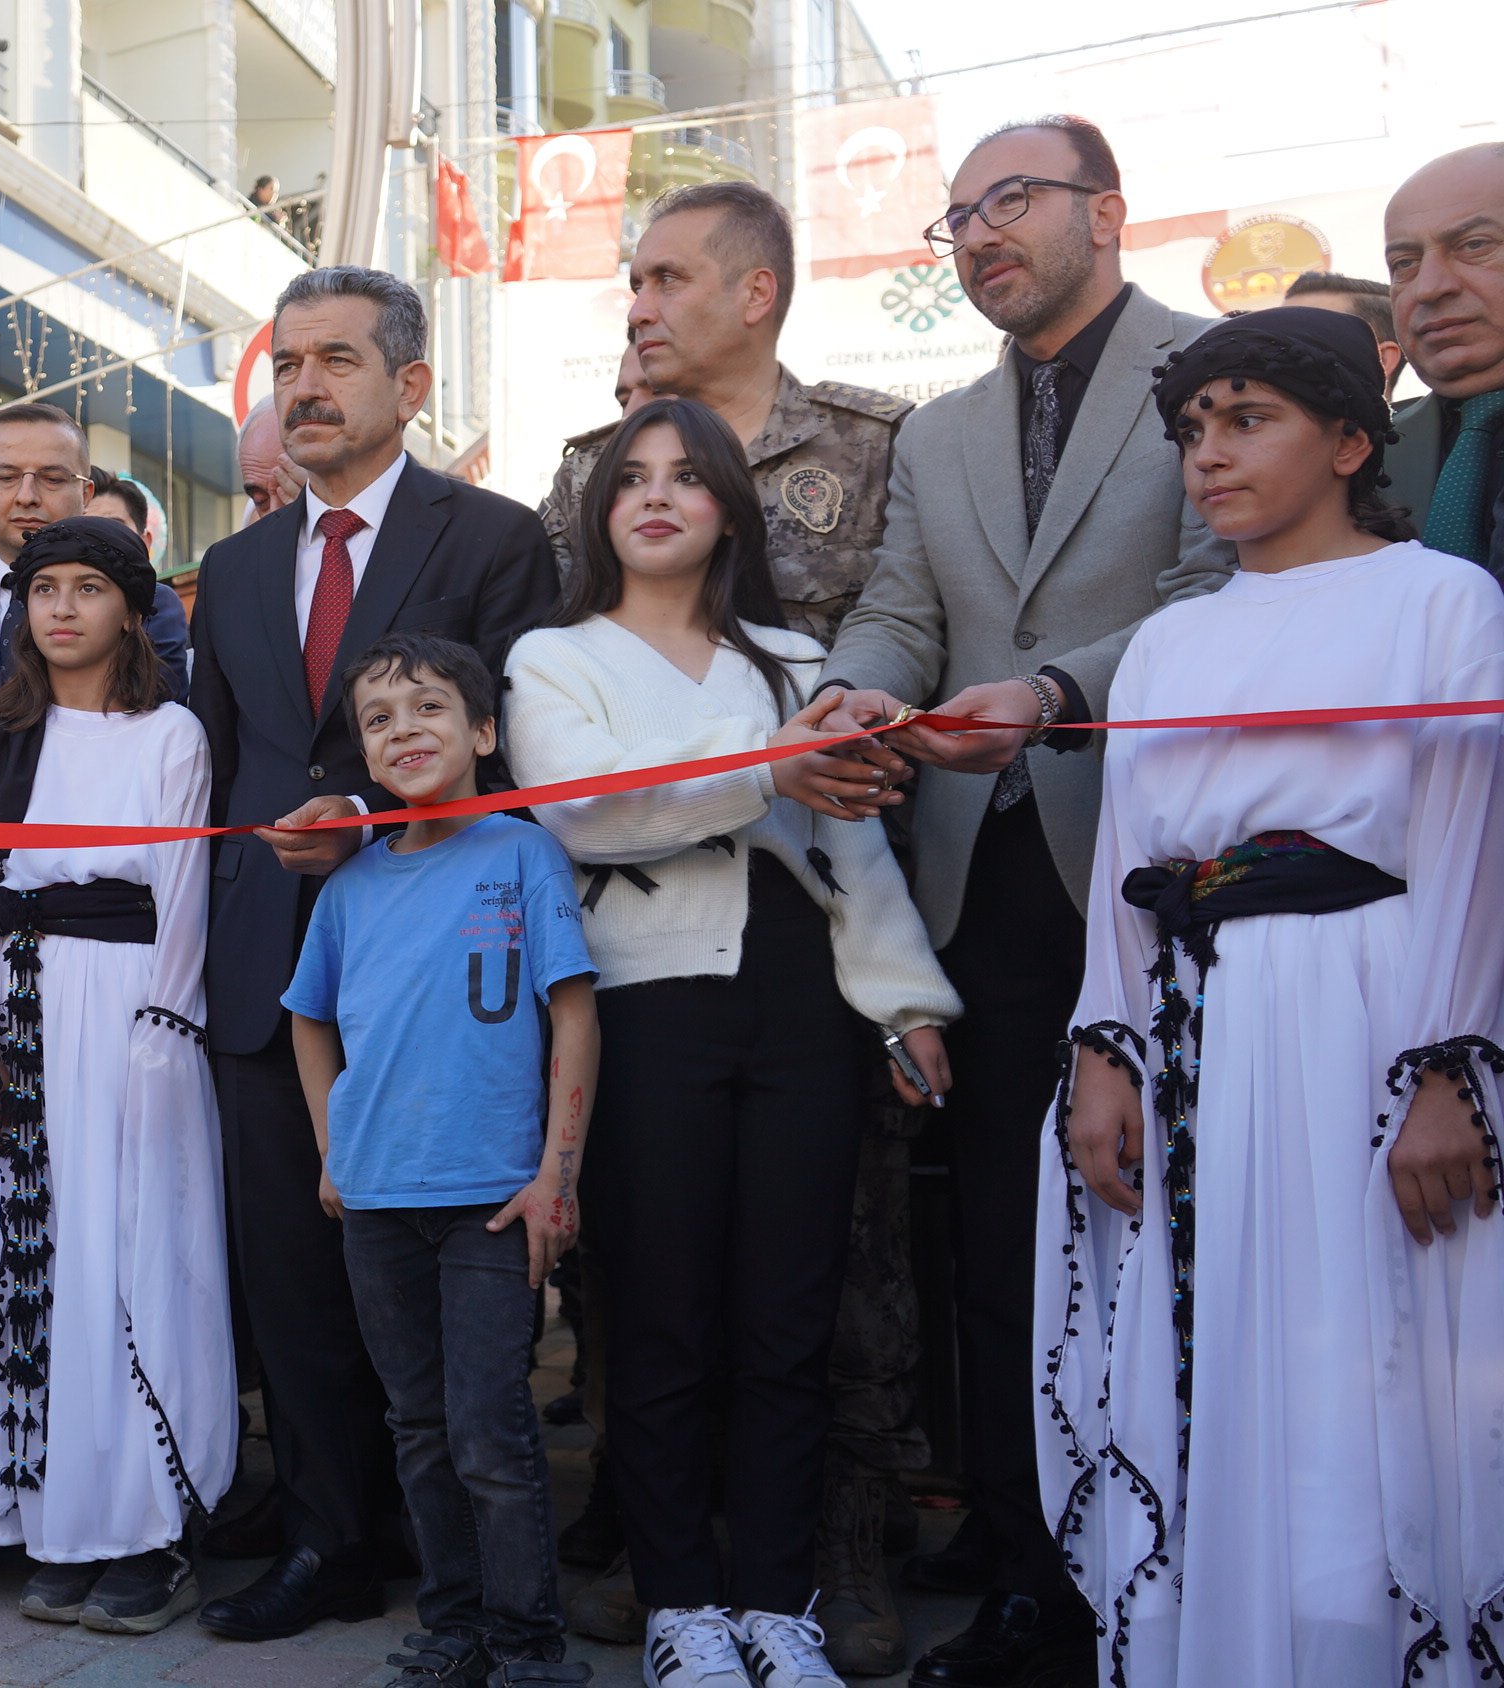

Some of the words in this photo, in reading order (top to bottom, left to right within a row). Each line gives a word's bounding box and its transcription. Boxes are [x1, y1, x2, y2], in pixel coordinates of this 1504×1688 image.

[882, 340, 996, 362] KAYMAKAML
[475, 881, 490, 892] the
[493, 881, 512, 891] best
[480, 894, 518, 908] original
[468, 948, 521, 1024] U
